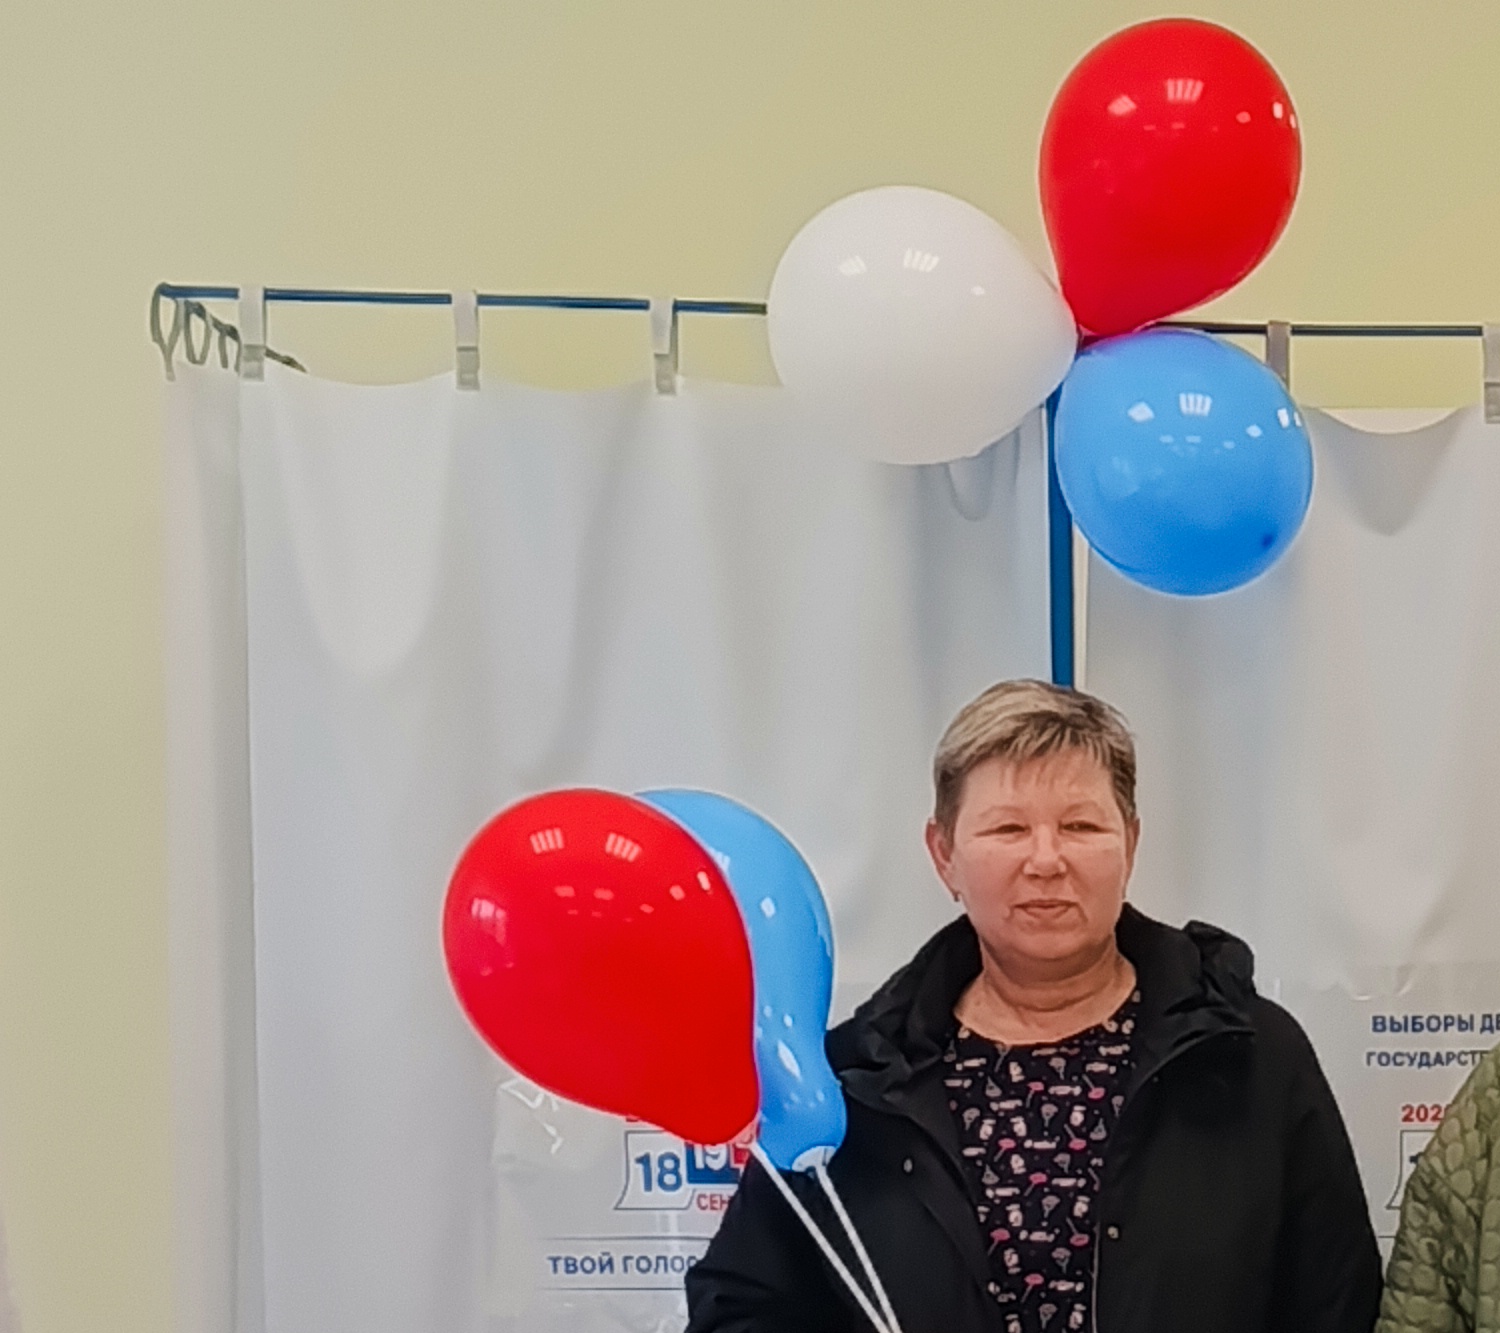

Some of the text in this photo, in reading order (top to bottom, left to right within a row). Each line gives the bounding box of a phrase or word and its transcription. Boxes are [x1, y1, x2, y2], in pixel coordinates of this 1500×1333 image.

[1371, 1014, 1475, 1034] ВЫБОРЫ
[1366, 1050, 1484, 1069] ГОСУДАРСТ
[1401, 1104, 1445, 1123] 202
[634, 1152, 684, 1193] 18
[696, 1193, 732, 1211] СЕН
[547, 1252, 615, 1275] ТВОЙ
